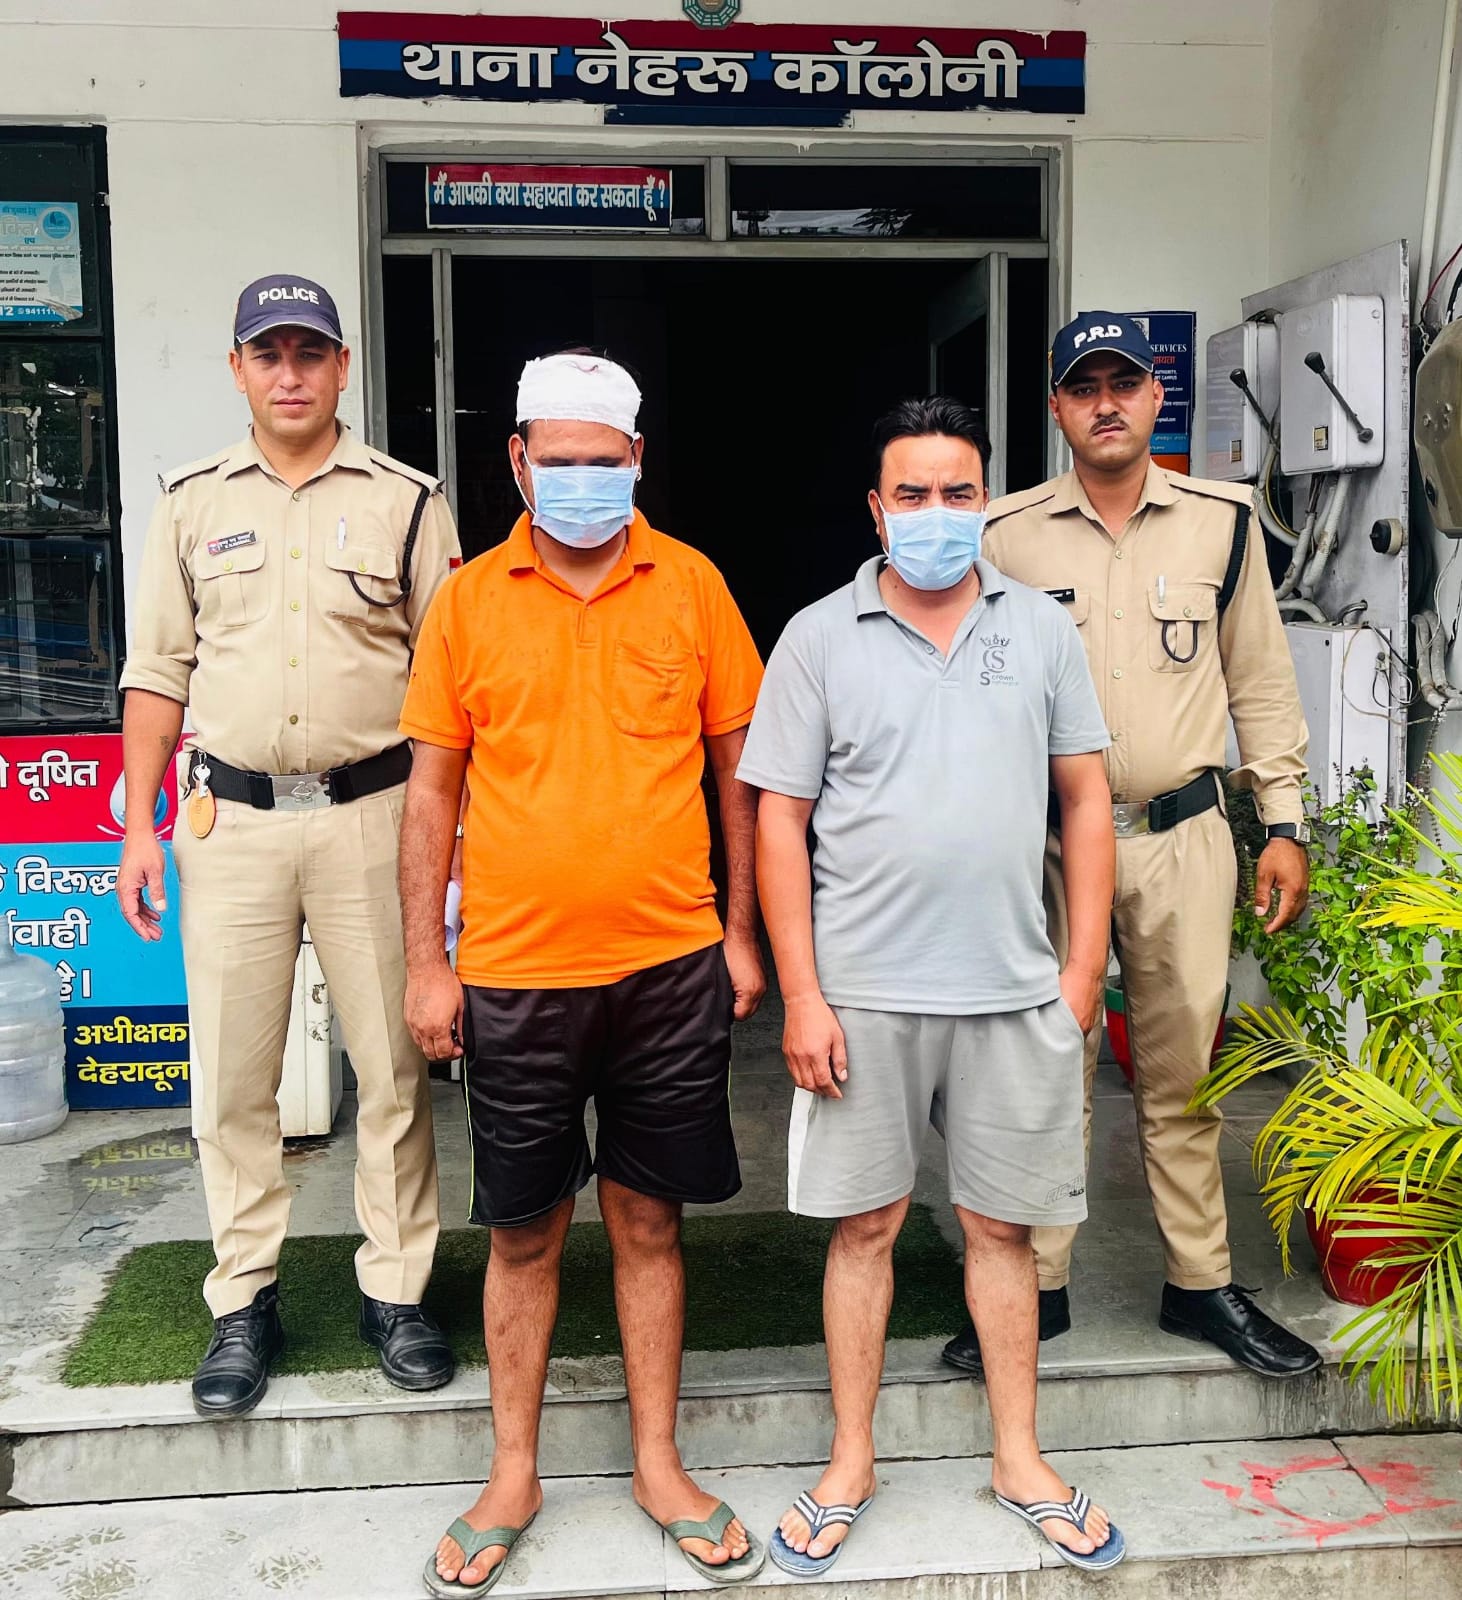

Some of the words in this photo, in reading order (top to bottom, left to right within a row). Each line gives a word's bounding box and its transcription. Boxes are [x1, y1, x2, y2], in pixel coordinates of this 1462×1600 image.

[402, 43, 559, 88] थाना
[573, 31, 755, 96] नेहरू
[770, 39, 1025, 99] कॉलोनी
[433, 170, 447, 205] मैं
[448, 171, 492, 206] आपकी
[494, 181, 520, 206] क्या
[522, 182, 574, 210] सहायता
[575, 183, 599, 208] कर
[600, 184, 641, 209] सकता
[658, 179, 665, 209] ?
[258, 286, 320, 306] POLICE
[1073, 324, 1123, 349] P.R.D
[1150, 344, 1187, 352] SERVICES
[16, 750, 99, 802] दूषित
[74, 1016, 190, 1045] अधीक्षक
[77, 1056, 191, 1091] देहरादून
